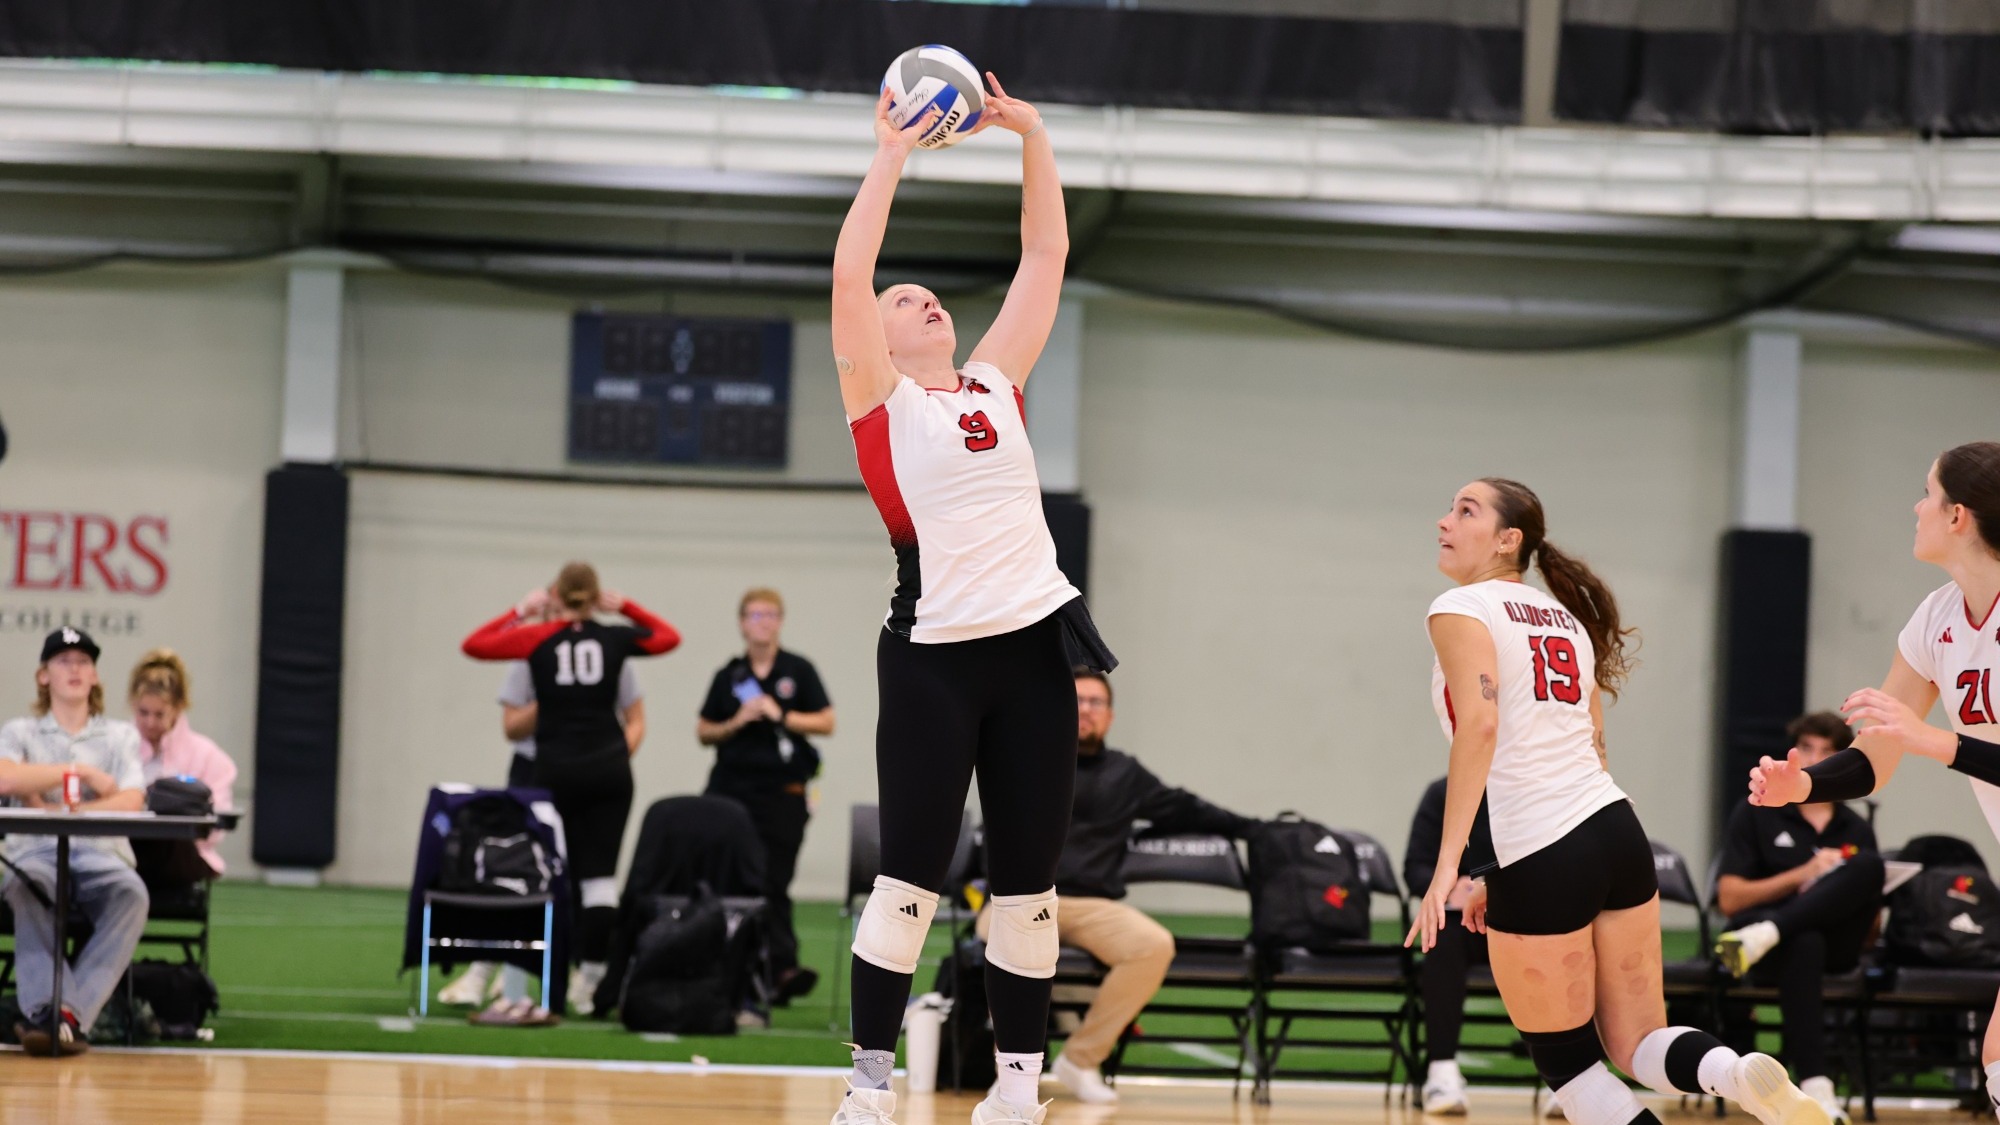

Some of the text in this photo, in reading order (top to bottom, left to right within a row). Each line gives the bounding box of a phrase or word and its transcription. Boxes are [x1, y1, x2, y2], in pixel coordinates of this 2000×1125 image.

[918, 110, 960, 148] molten
[958, 410, 998, 452] 9
[0, 510, 169, 597] ERS
[555, 638, 604, 686] 10
[1528, 634, 1581, 705] 19
[1956, 668, 1998, 725] 21
